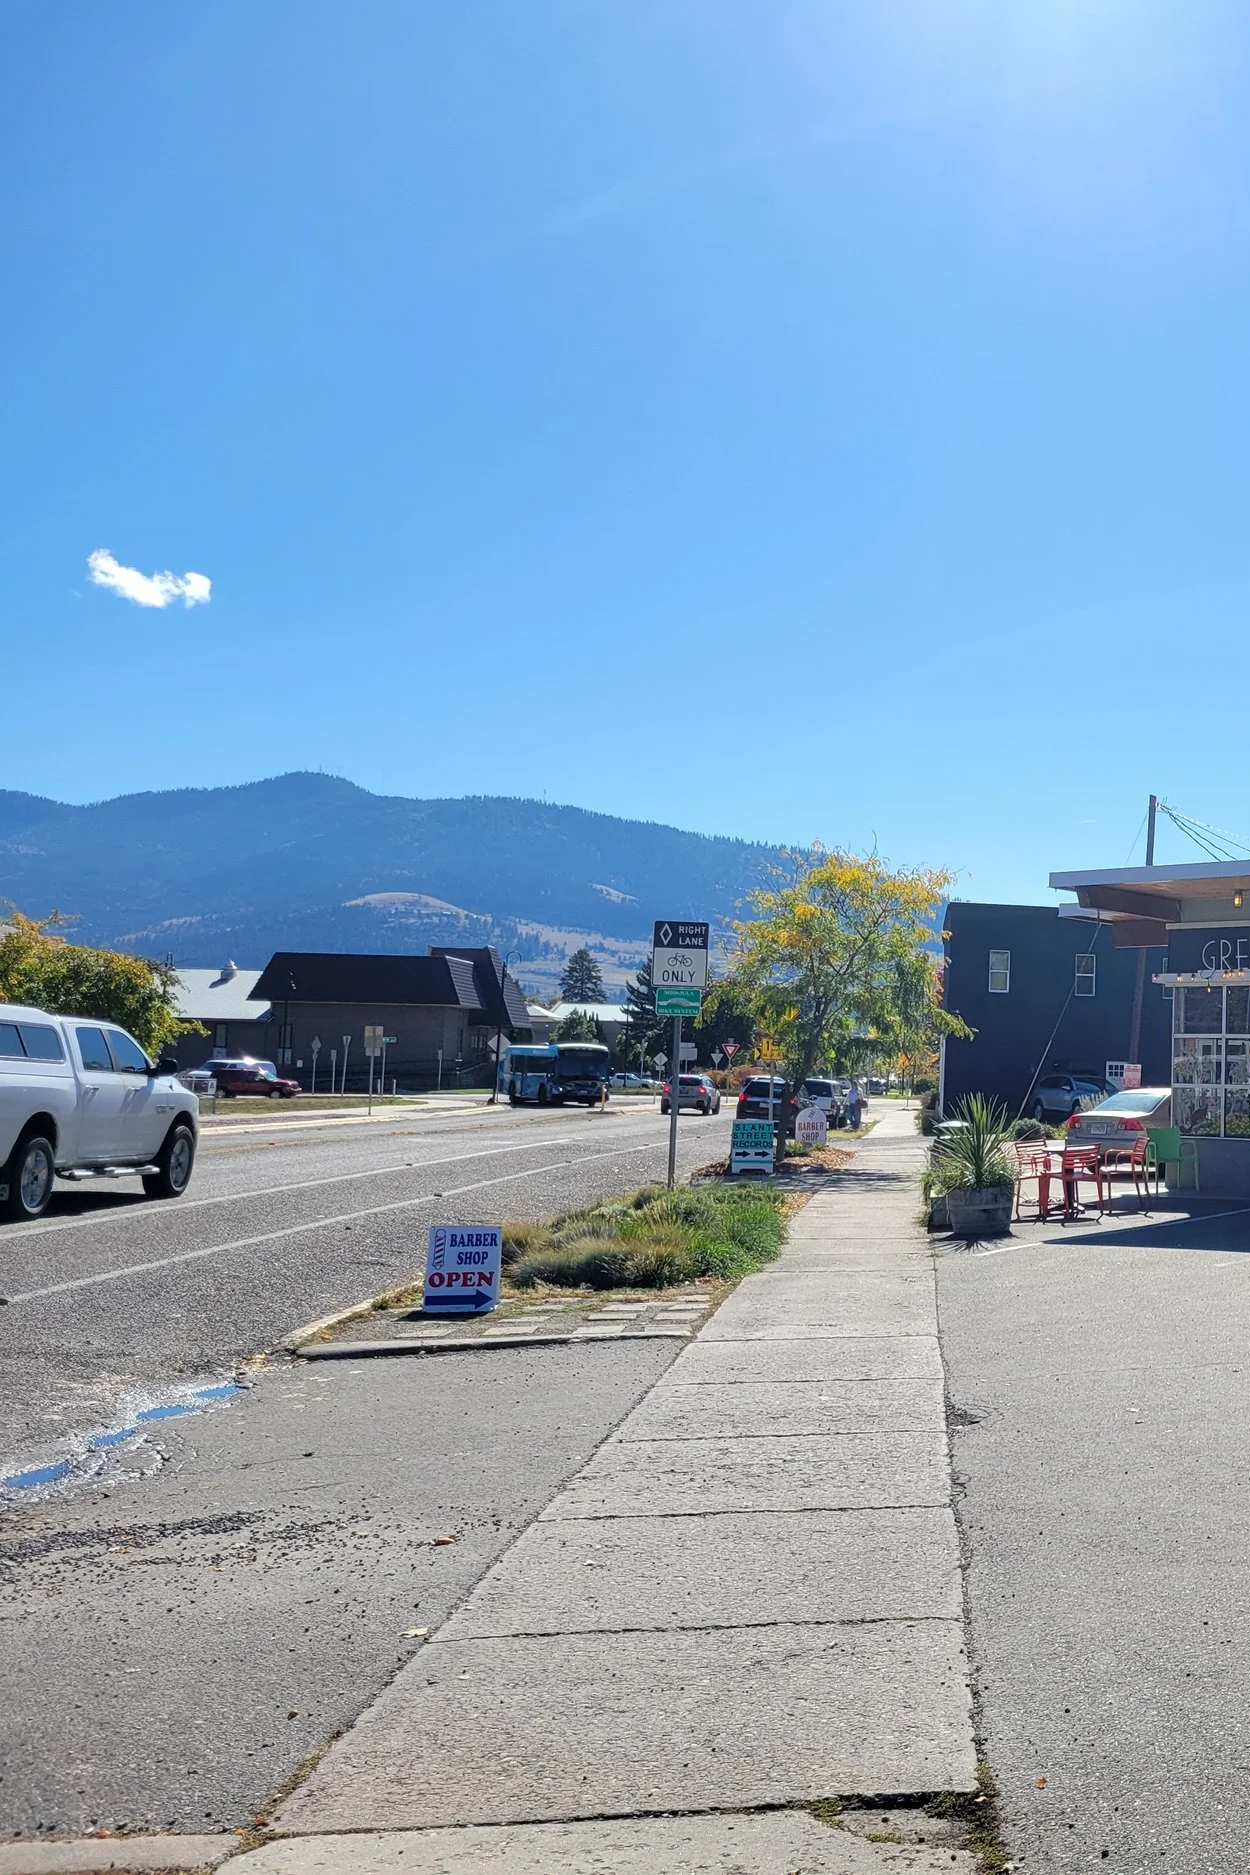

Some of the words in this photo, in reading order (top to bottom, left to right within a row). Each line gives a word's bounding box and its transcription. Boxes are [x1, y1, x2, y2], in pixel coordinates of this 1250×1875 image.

[678, 925, 707, 935] RIGHT
[678, 936, 705, 946] LANE
[661, 969, 696, 983] ONLY
[735, 1123, 772, 1132] SLANT
[798, 1121, 824, 1131] BARBER
[733, 1131, 774, 1140] STREET
[801, 1131, 820, 1141] SHOP
[733, 1140, 773, 1148] RECORDS
[449, 1233, 498, 1248] BARBER
[456, 1251, 489, 1266] SHOP
[428, 1271, 495, 1288] OPEN
